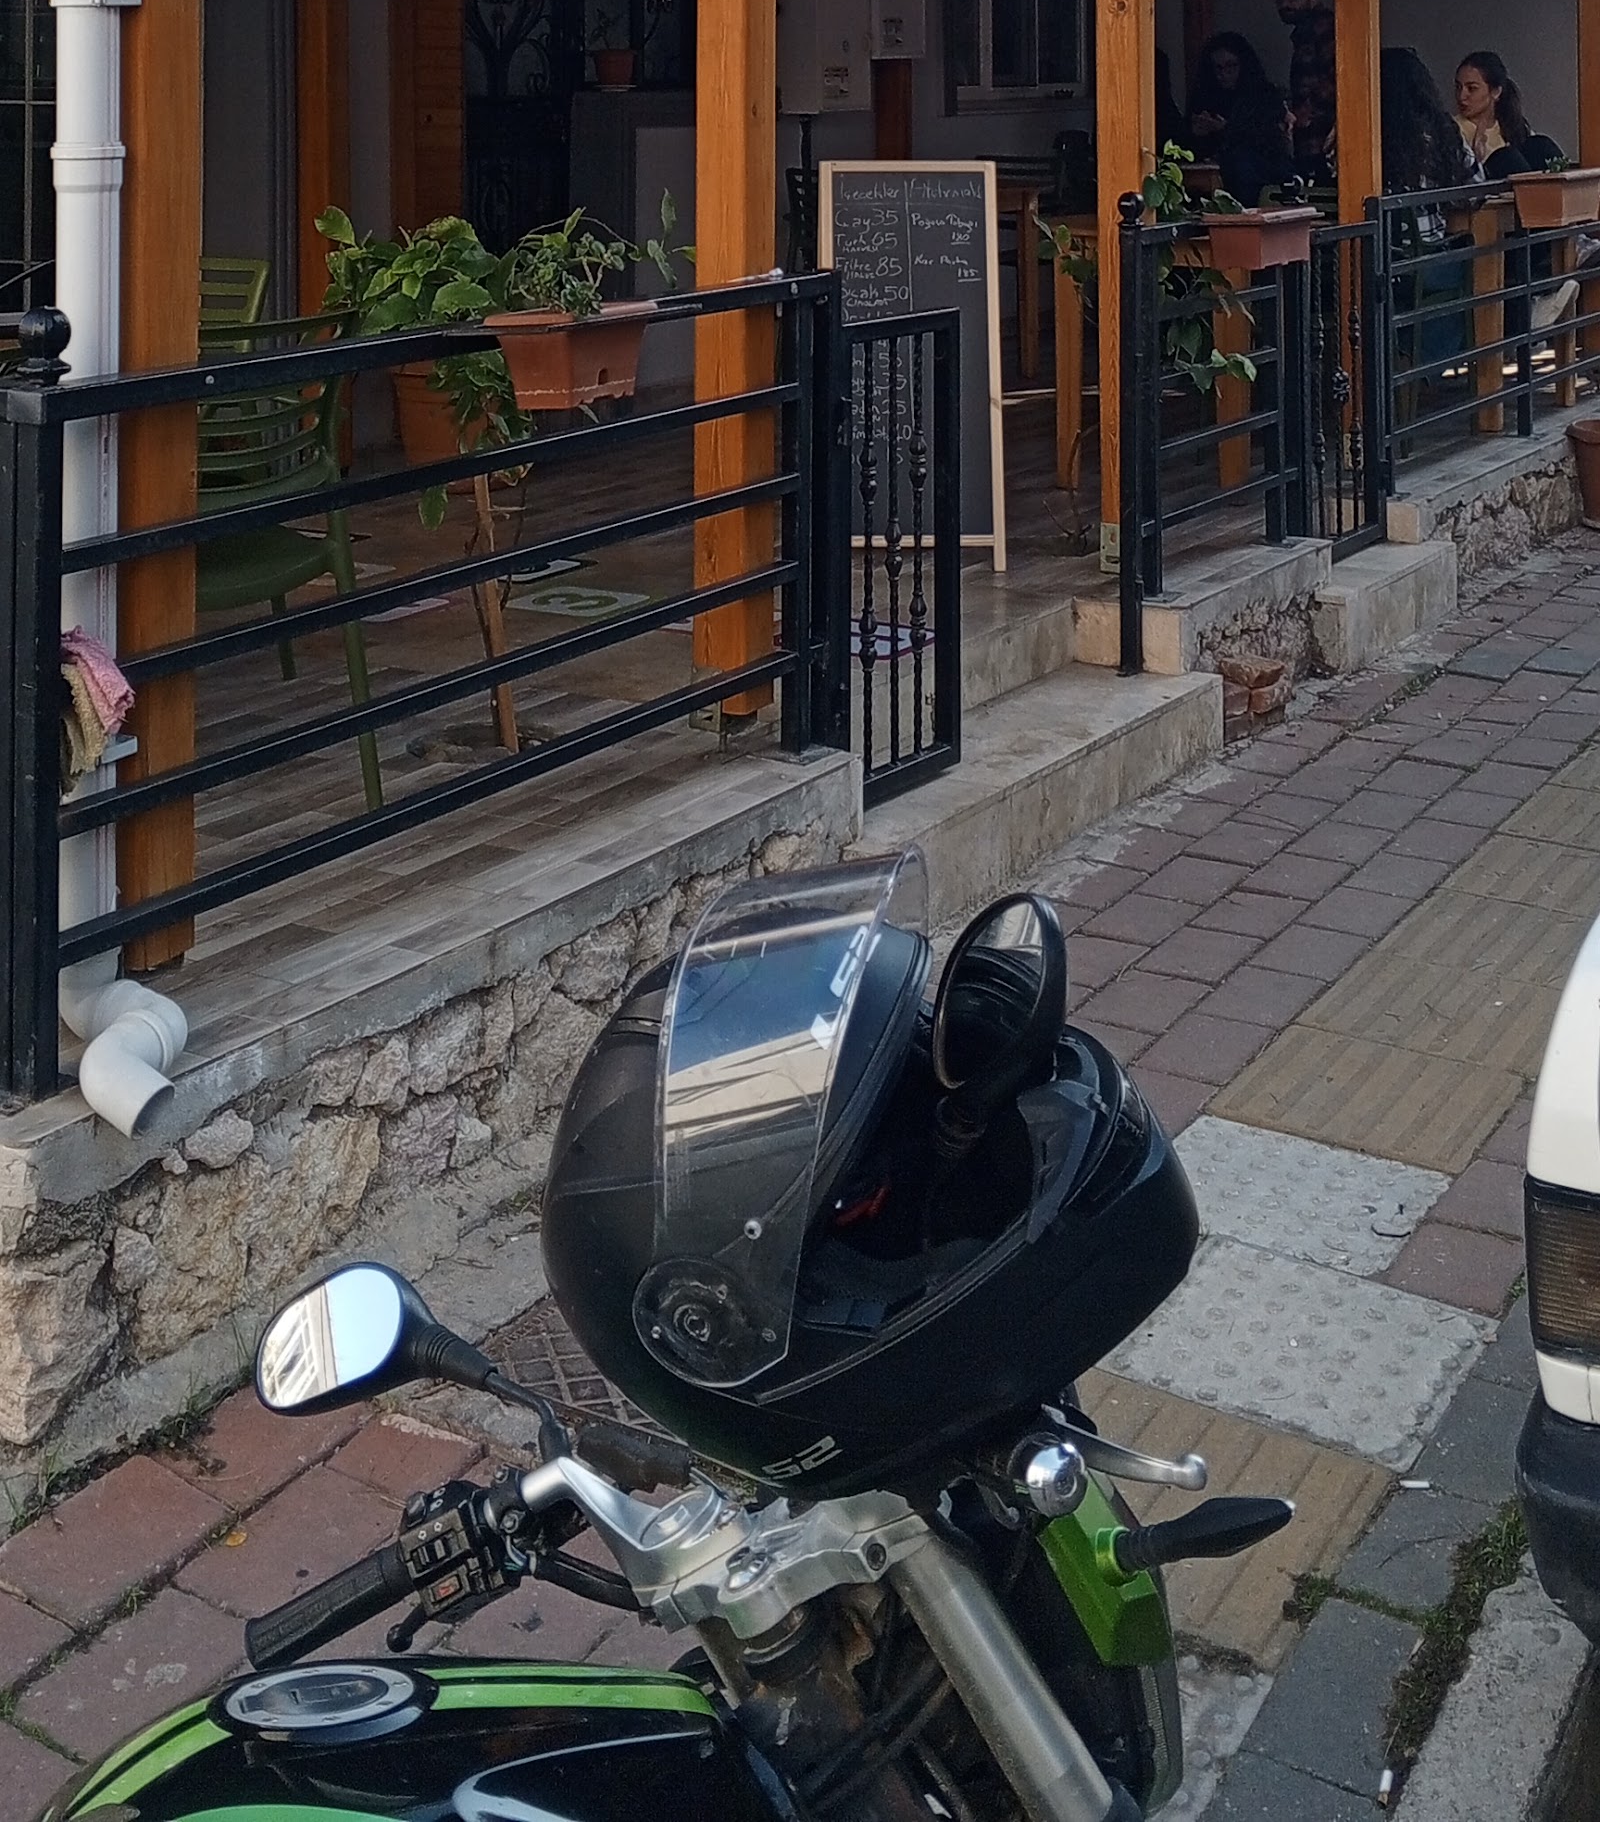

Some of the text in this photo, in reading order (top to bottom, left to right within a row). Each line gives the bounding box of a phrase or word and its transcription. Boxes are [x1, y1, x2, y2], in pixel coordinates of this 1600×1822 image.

[871, 208, 899, 226] 35
[872, 231, 898, 249] 65
[875, 255, 902, 276] 85
[884, 285, 908, 301] 50
